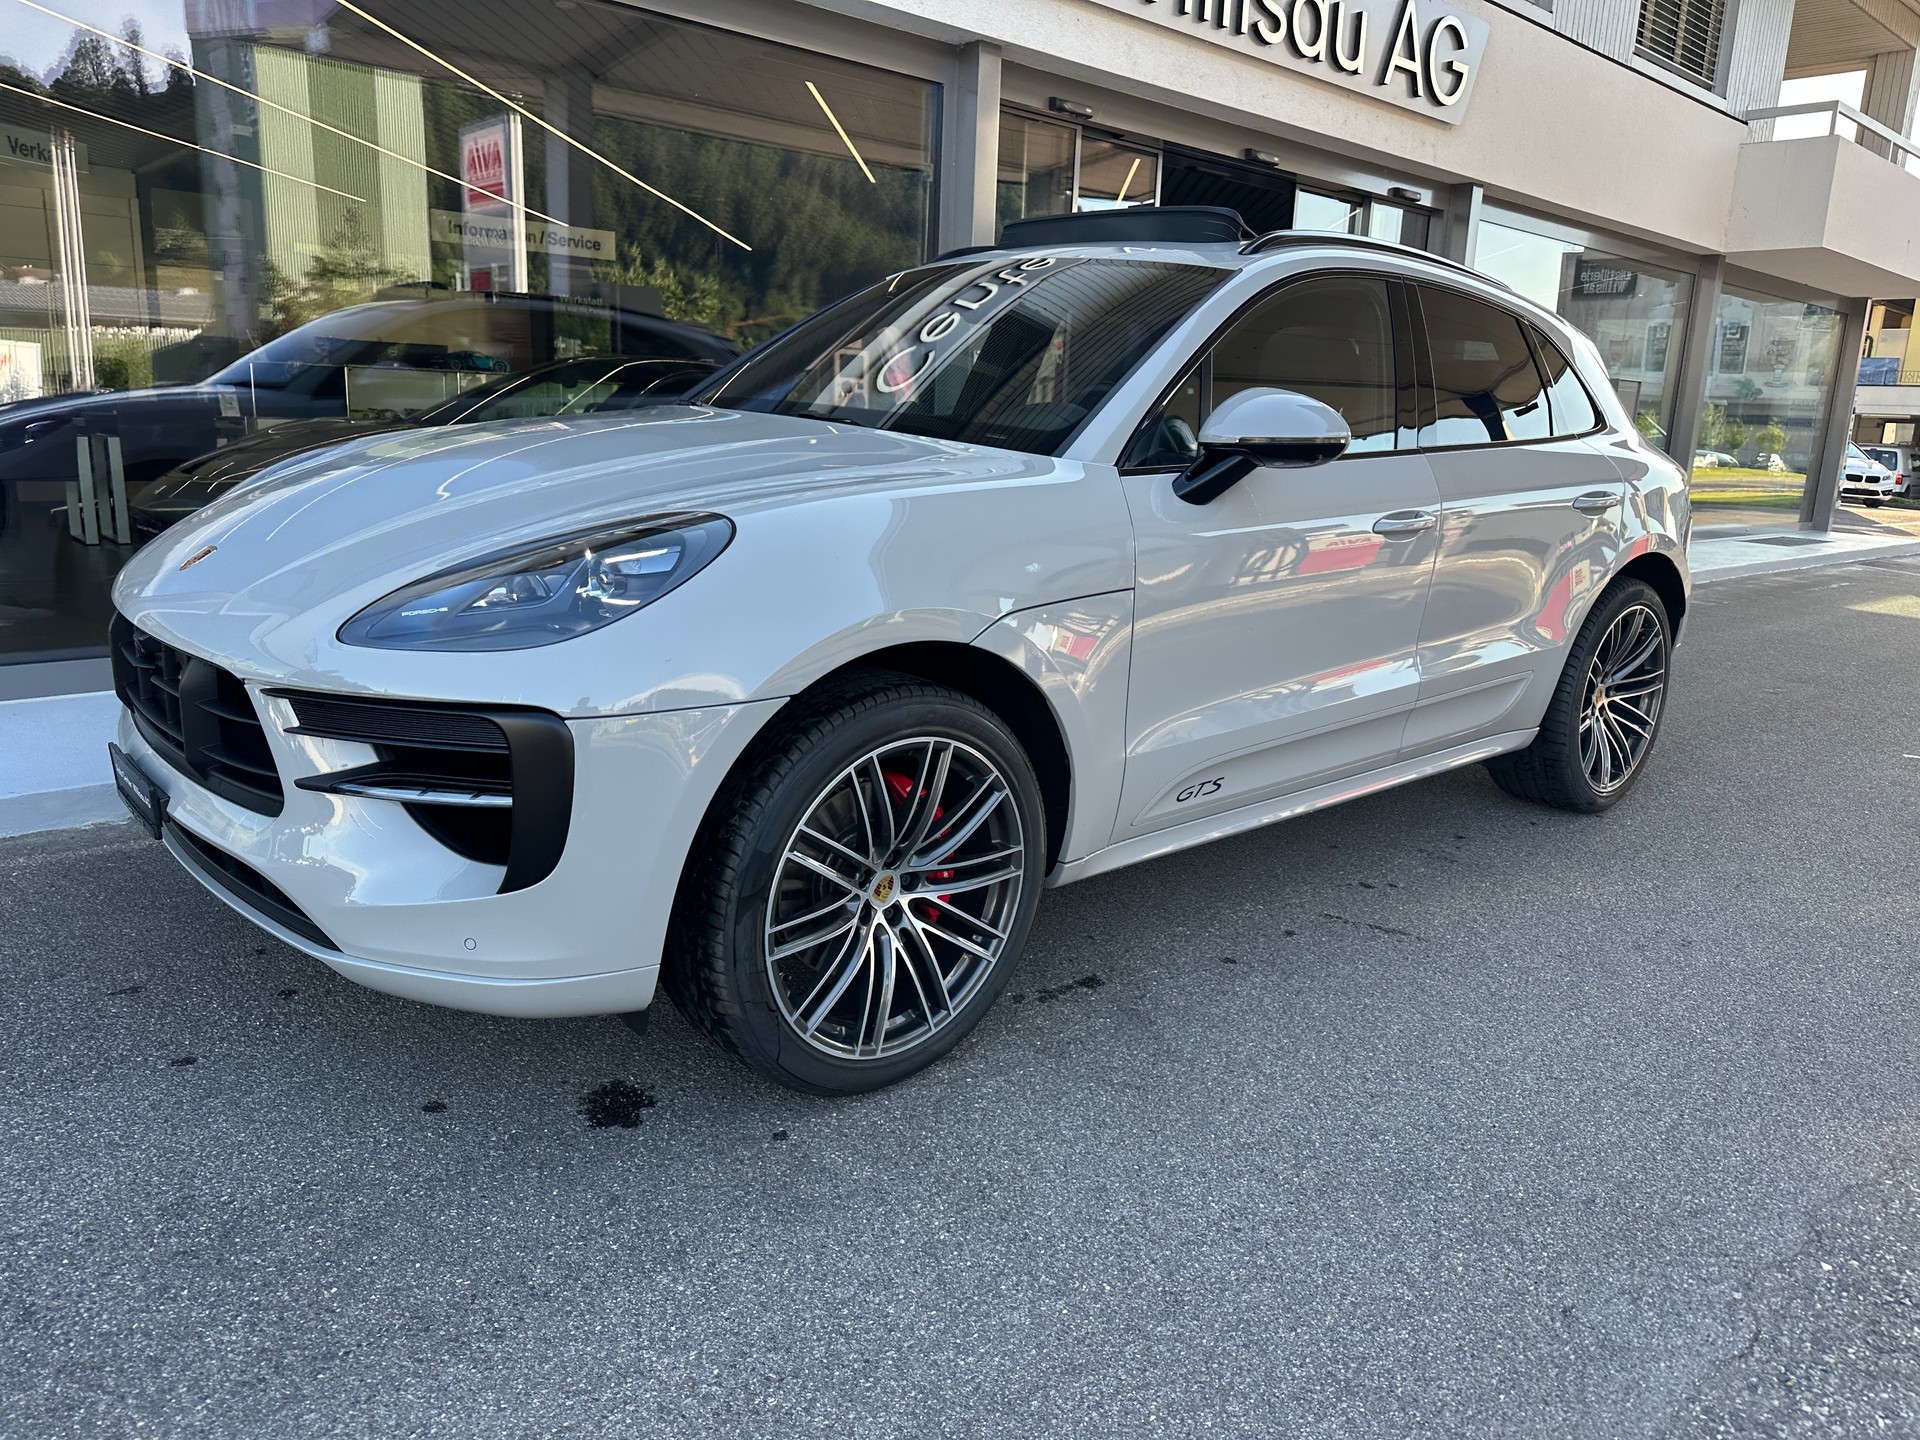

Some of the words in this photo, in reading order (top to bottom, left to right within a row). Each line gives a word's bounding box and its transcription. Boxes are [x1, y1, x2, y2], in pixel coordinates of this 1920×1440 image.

[1379, 0, 1470, 106] AG
[548, 231, 601, 251] Service
[401, 607, 448, 617] PORSCHE
[1176, 776, 1225, 803] GTS
